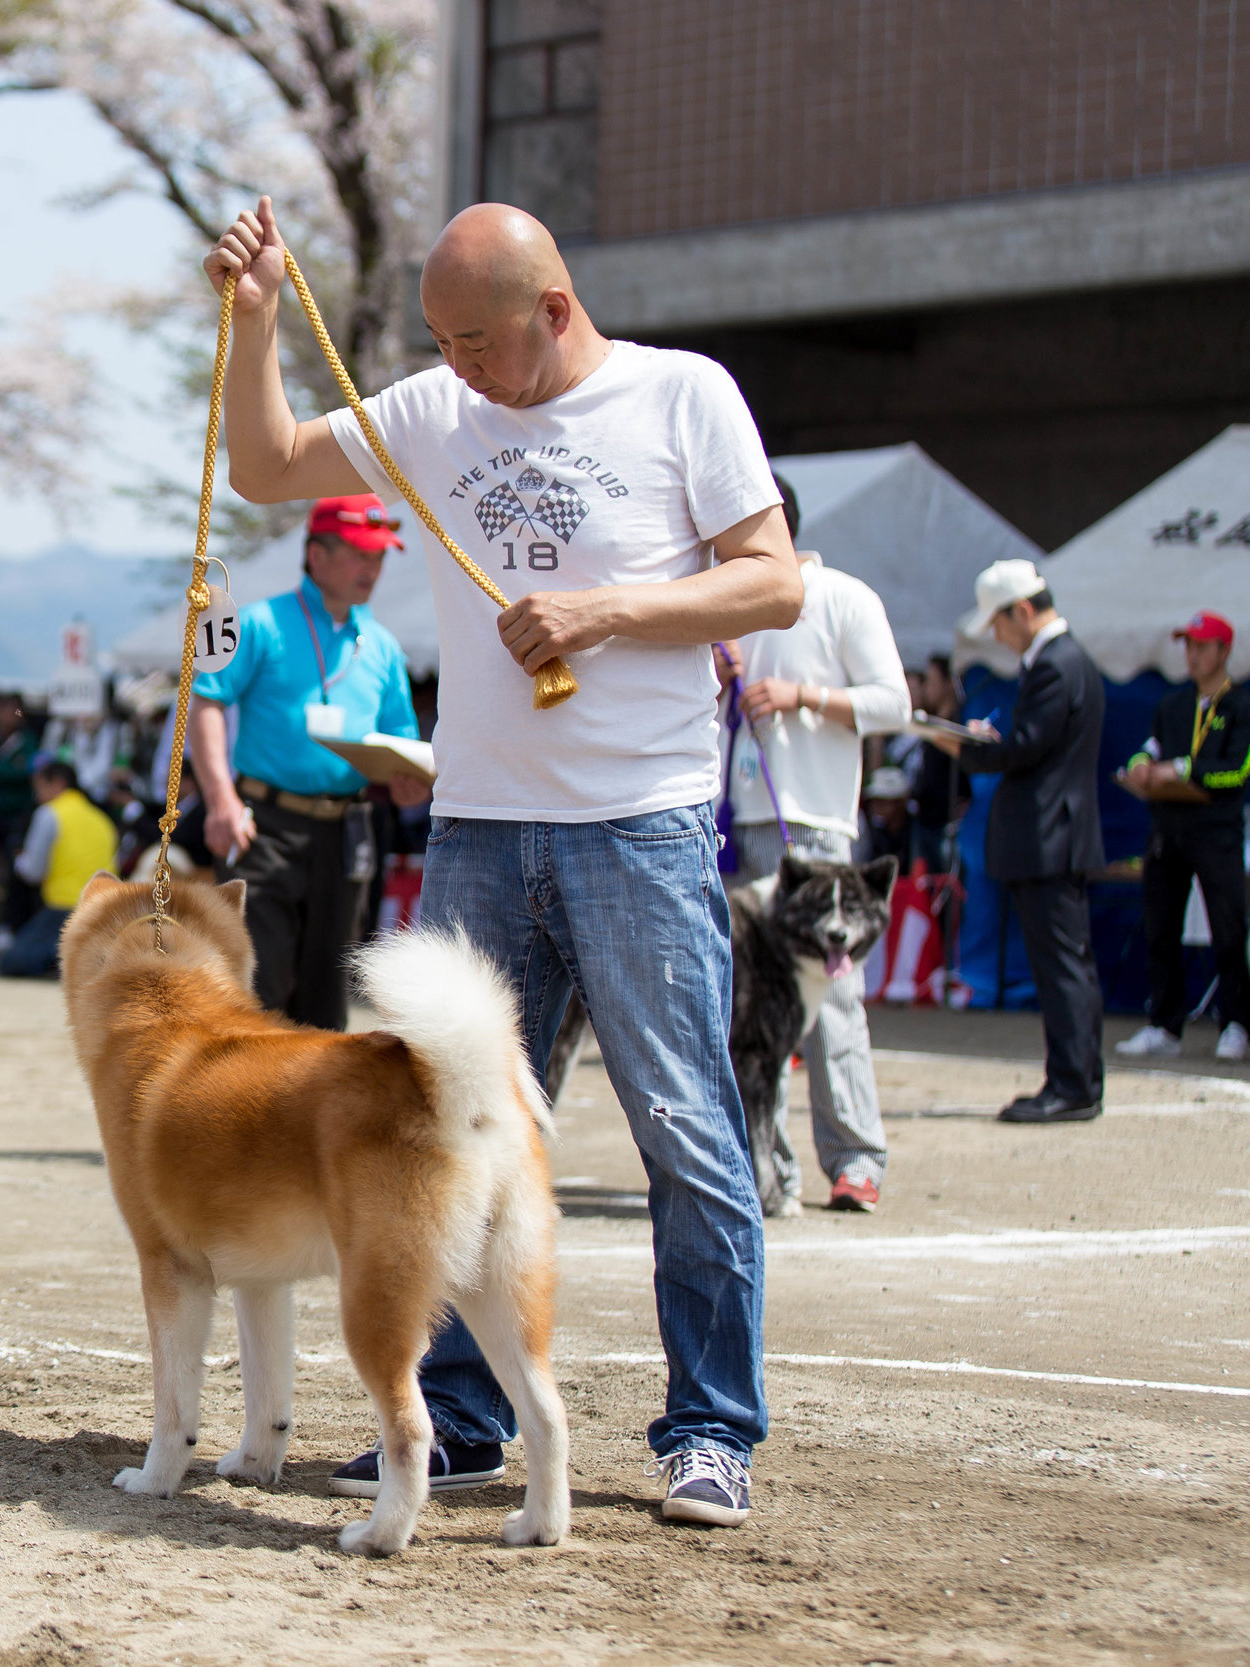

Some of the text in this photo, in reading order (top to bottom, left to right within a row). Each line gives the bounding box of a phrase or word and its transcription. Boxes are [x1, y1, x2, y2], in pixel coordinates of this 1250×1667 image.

[449, 466, 485, 499] THE
[573, 455, 630, 499] CLUB
[502, 541, 559, 572] 18
[186, 616, 237, 658] 15
